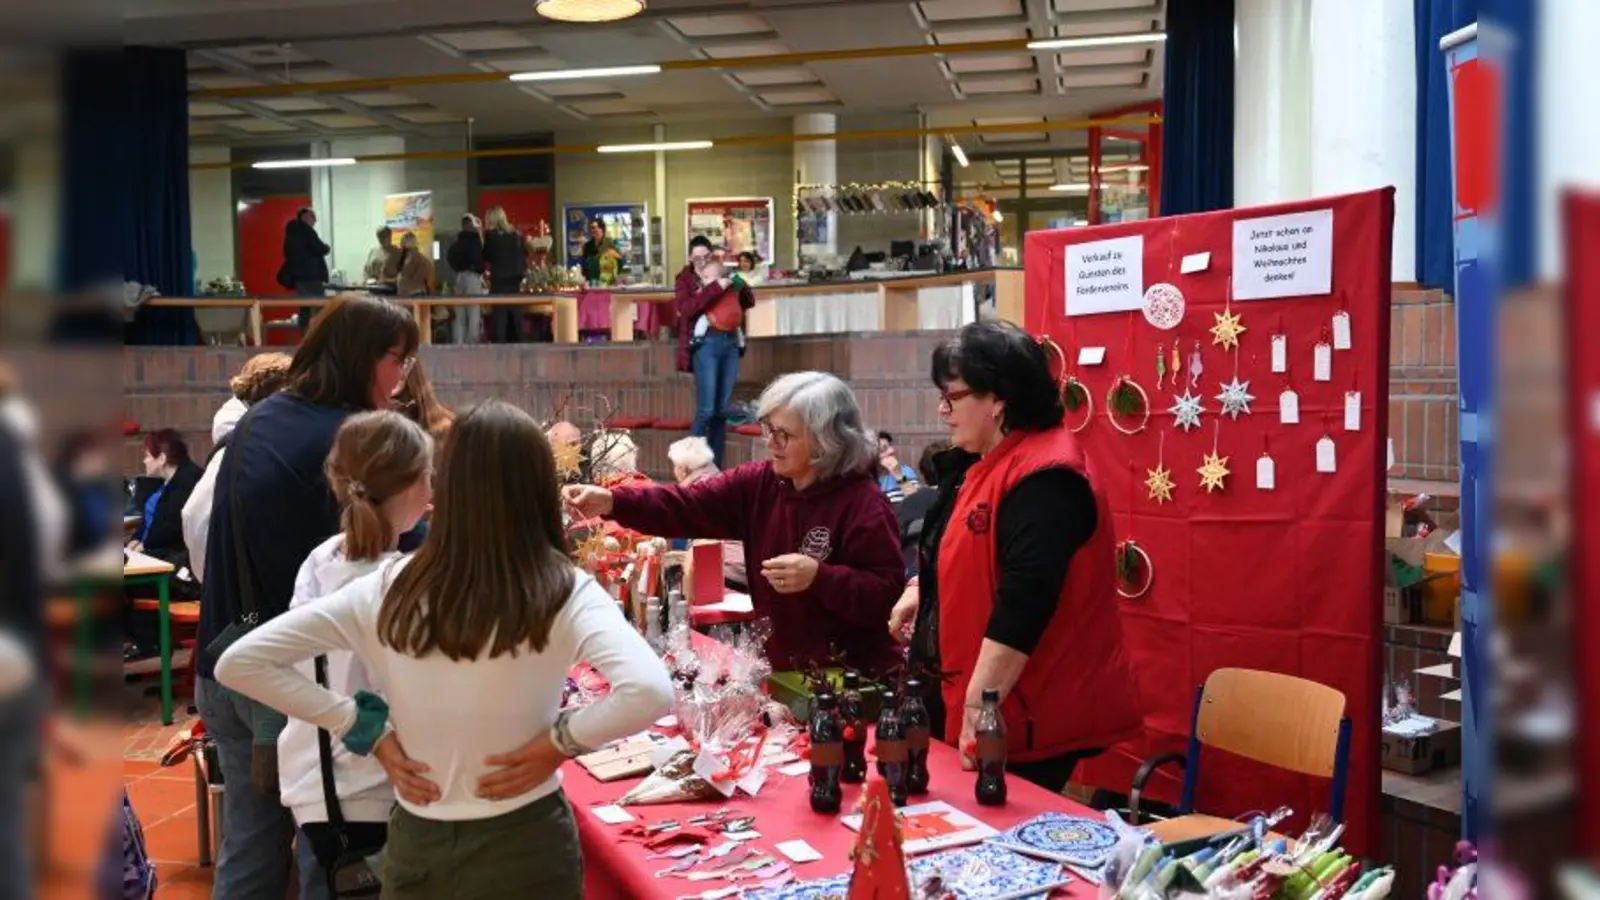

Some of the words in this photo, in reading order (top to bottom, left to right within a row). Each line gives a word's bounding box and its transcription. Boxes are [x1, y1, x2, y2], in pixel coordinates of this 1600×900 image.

[1292, 240, 1307, 251] und
[1081, 249, 1111, 263] Verkauf
[1112, 266, 1126, 276] des
